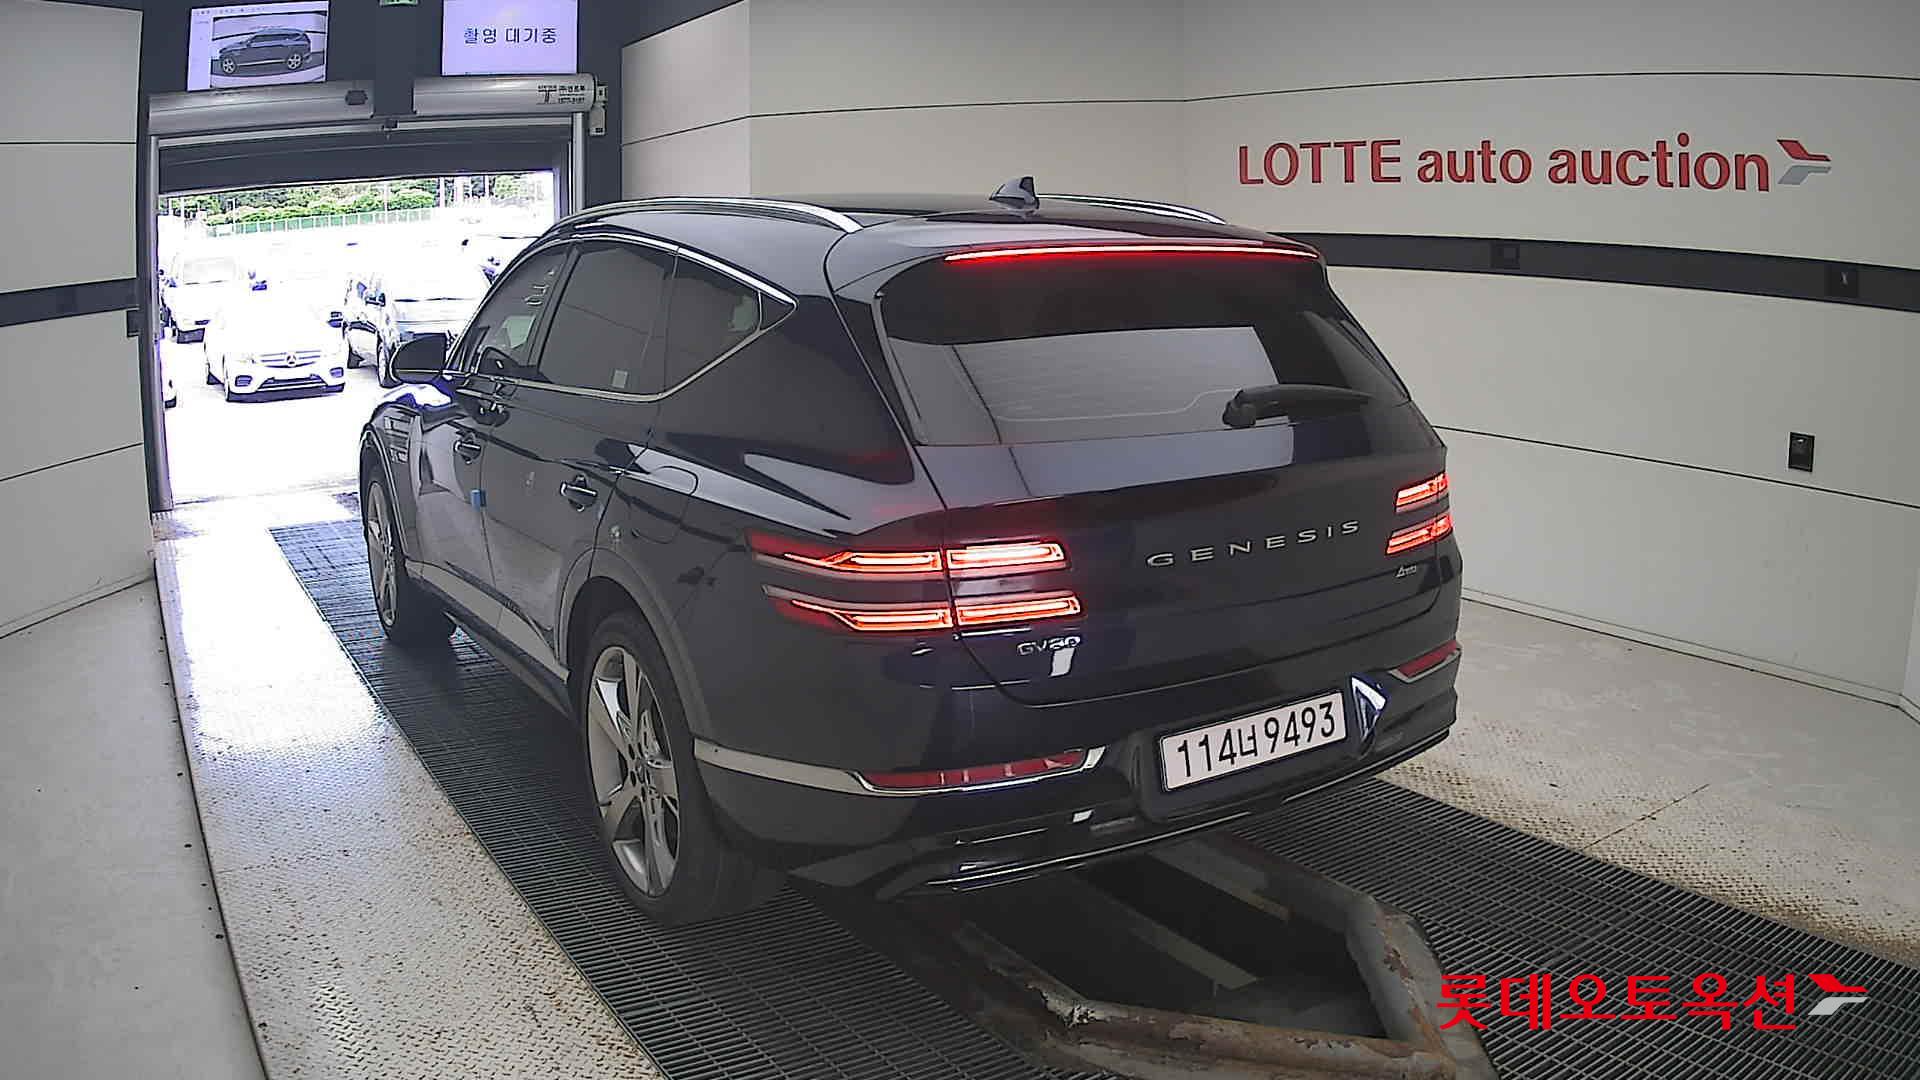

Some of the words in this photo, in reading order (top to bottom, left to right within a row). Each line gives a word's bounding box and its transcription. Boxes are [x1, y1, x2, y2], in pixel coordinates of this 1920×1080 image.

[505, 27, 557, 44] 대기중
[1238, 138, 1401, 186] LOTTE
[1416, 140, 1533, 184] auto
[1547, 132, 1770, 192] auction
[1146, 519, 1360, 567] GENESIS
[1016, 635, 1081, 656] GV80
